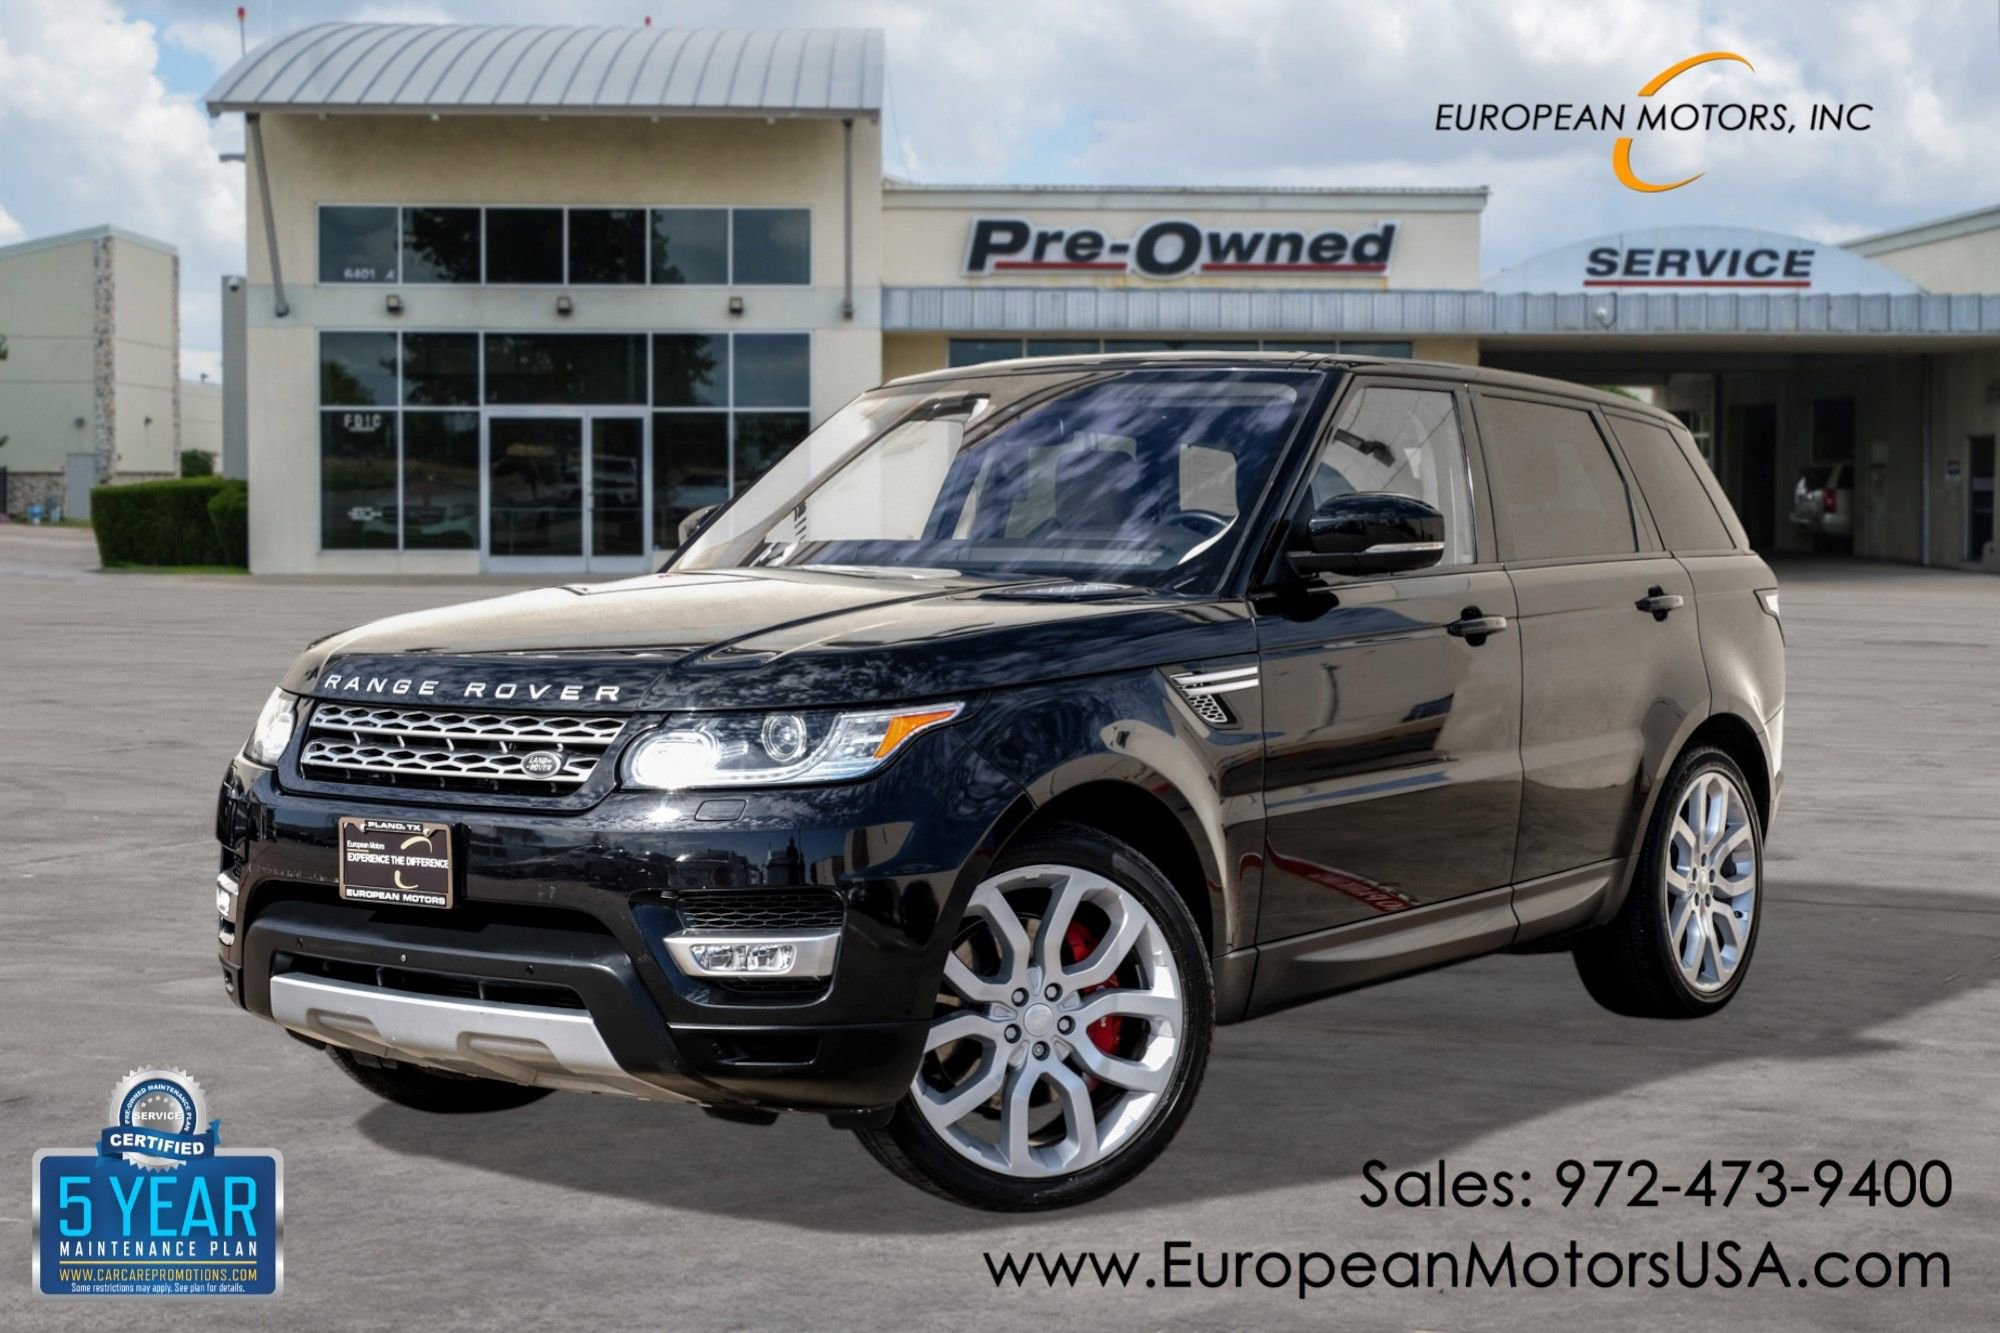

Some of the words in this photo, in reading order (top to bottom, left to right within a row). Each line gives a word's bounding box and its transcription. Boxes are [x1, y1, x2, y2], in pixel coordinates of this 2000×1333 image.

[967, 219, 1396, 276] Pre-Owned
[1585, 248, 1815, 278] SERVICE
[324, 674, 440, 696] RANGE
[463, 682, 621, 701] ROVER
[346, 840, 369, 849] European
[347, 853, 391, 865] EXPERIENCE
[391, 856, 405, 866] THE
[406, 857, 449, 869] DIFFERENCE
[346, 889, 400, 901] EUROPEAN
[402, 894, 446, 905] MOTORS
